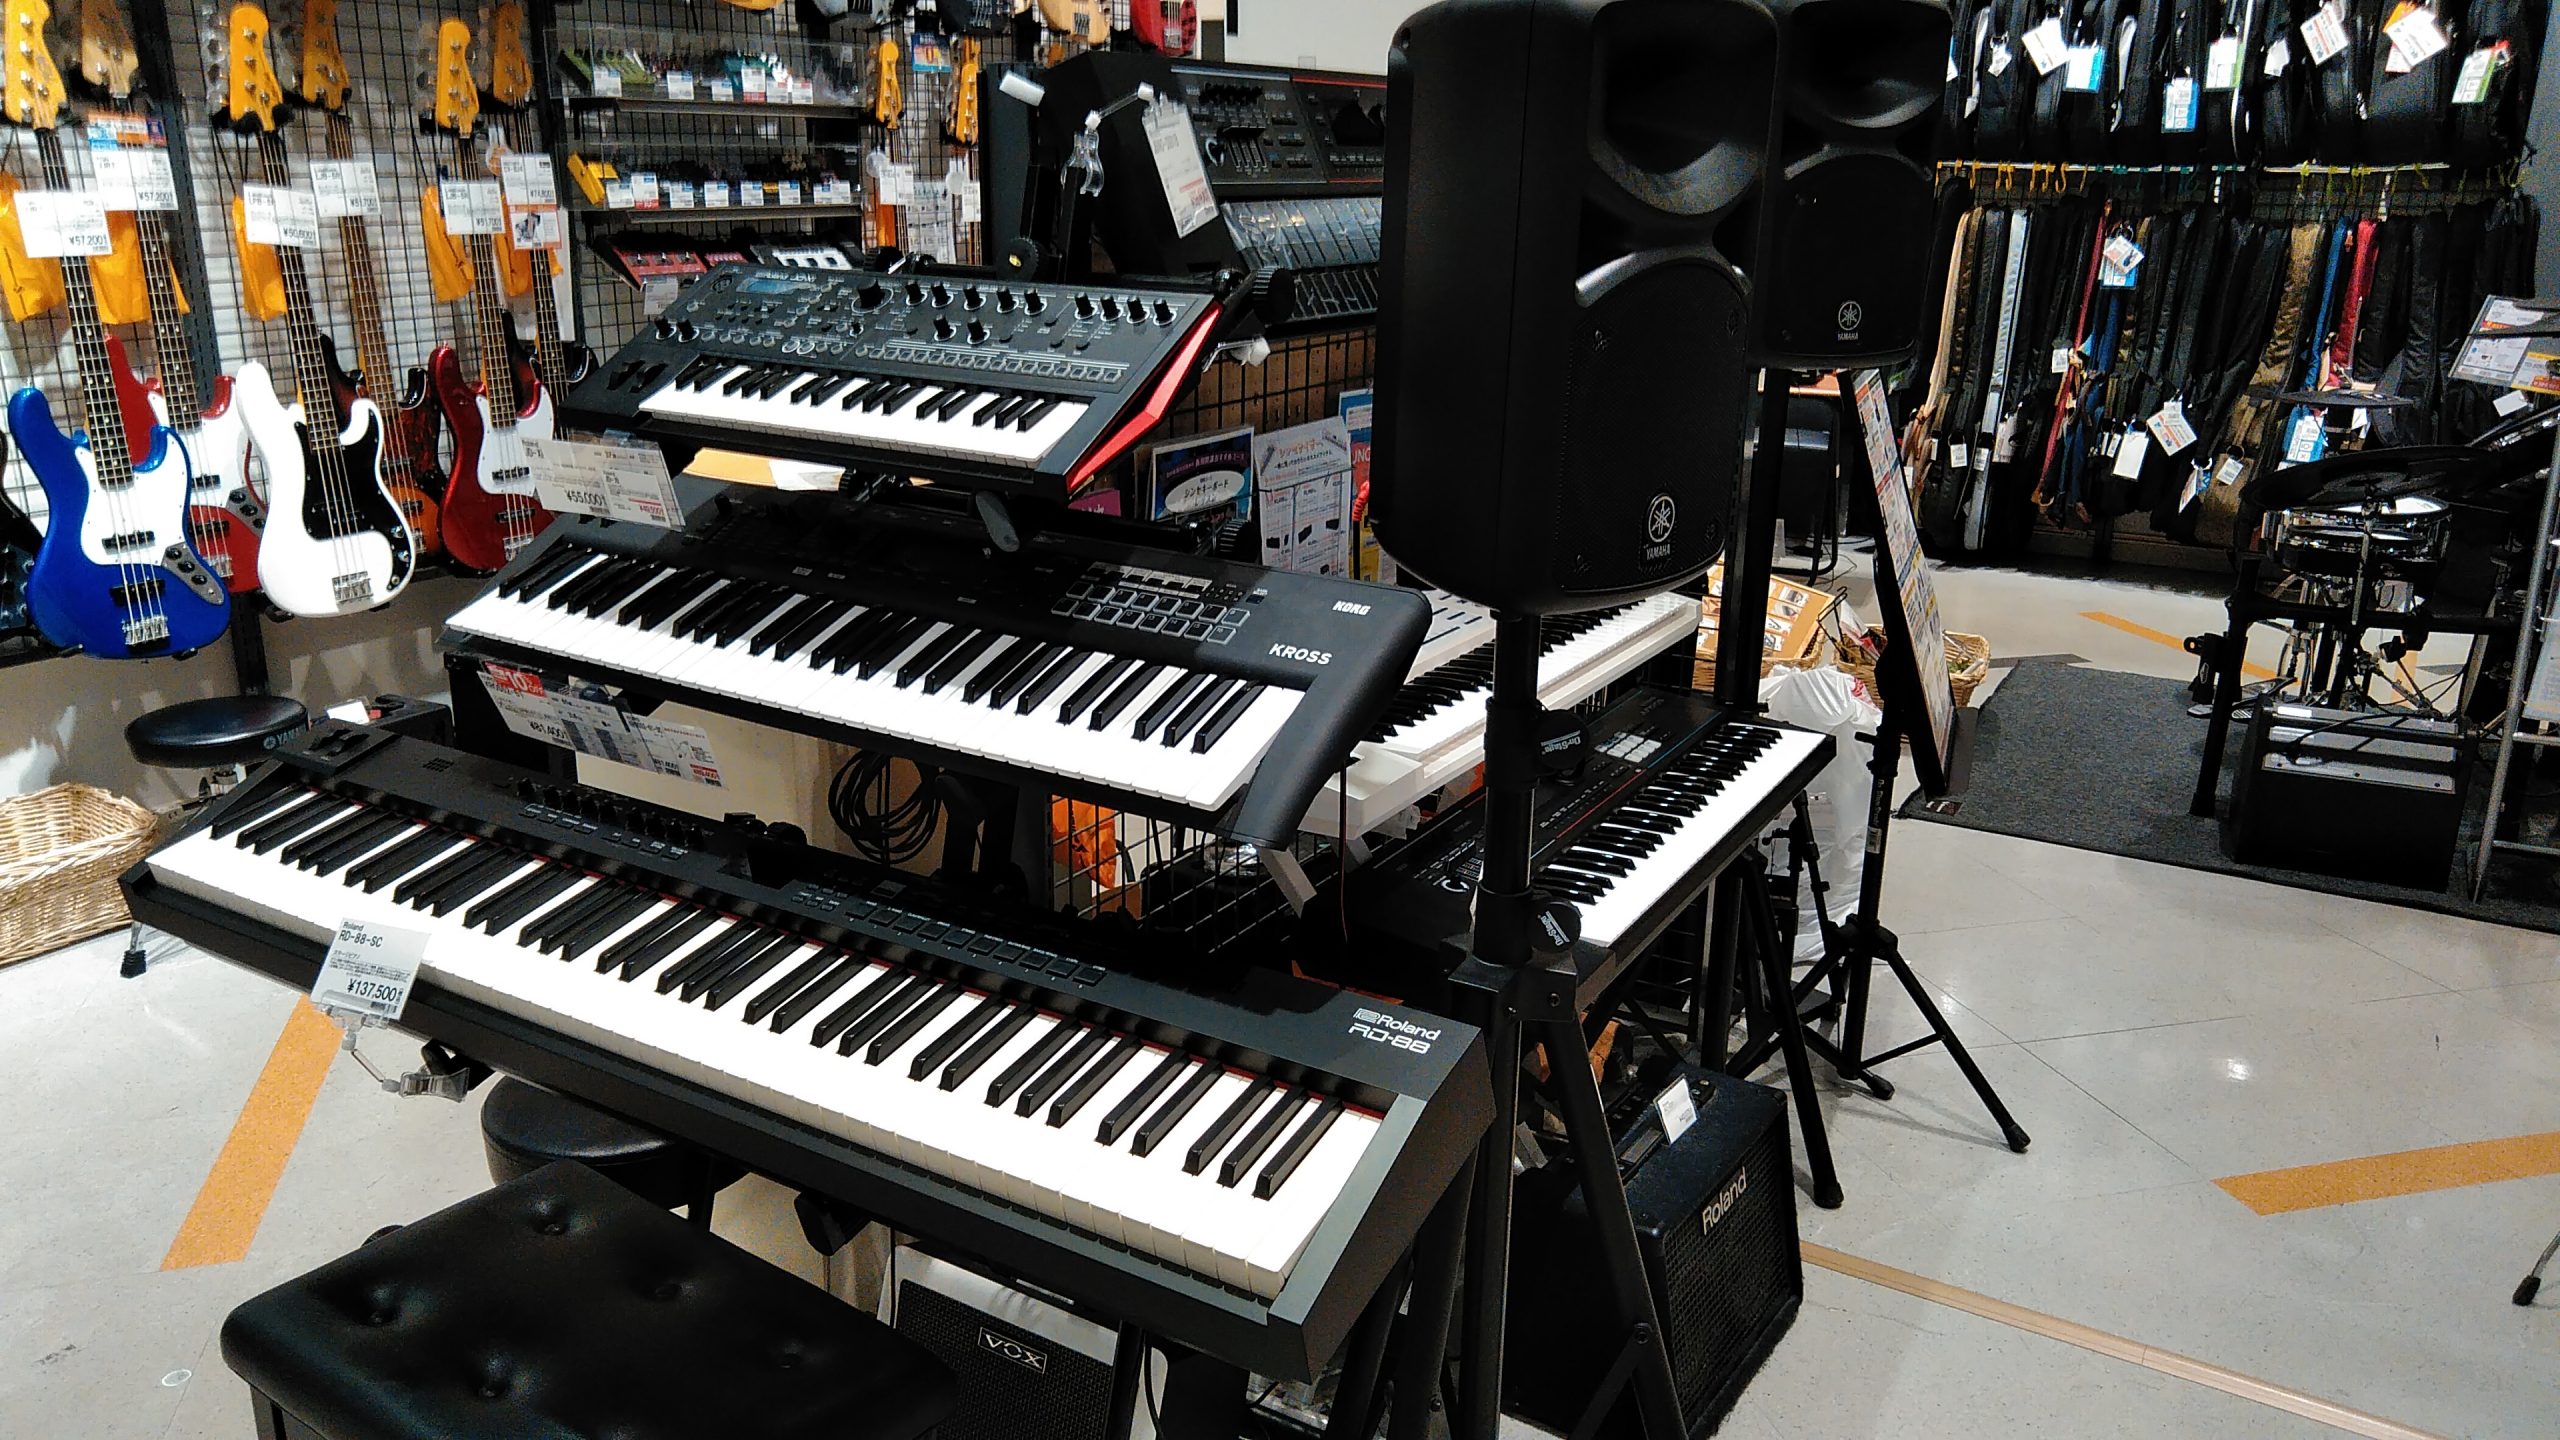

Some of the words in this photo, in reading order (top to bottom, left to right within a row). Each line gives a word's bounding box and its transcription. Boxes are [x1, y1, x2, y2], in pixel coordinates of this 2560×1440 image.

[1646, 543, 1671, 560] YAMAHA
[1332, 600, 1371, 616] KORG
[1268, 643, 1333, 665] KROSS
[343, 922, 364, 932] Roland
[339, 930, 383, 948] RD-88-SC
[347, 978, 397, 1002] ¥137,500
[1348, 1022, 1431, 1055] RD-88
[1377, 1014, 1441, 1041] Roland
[1702, 1167, 1747, 1236] Roland
[986, 1334, 1044, 1370] VOX
